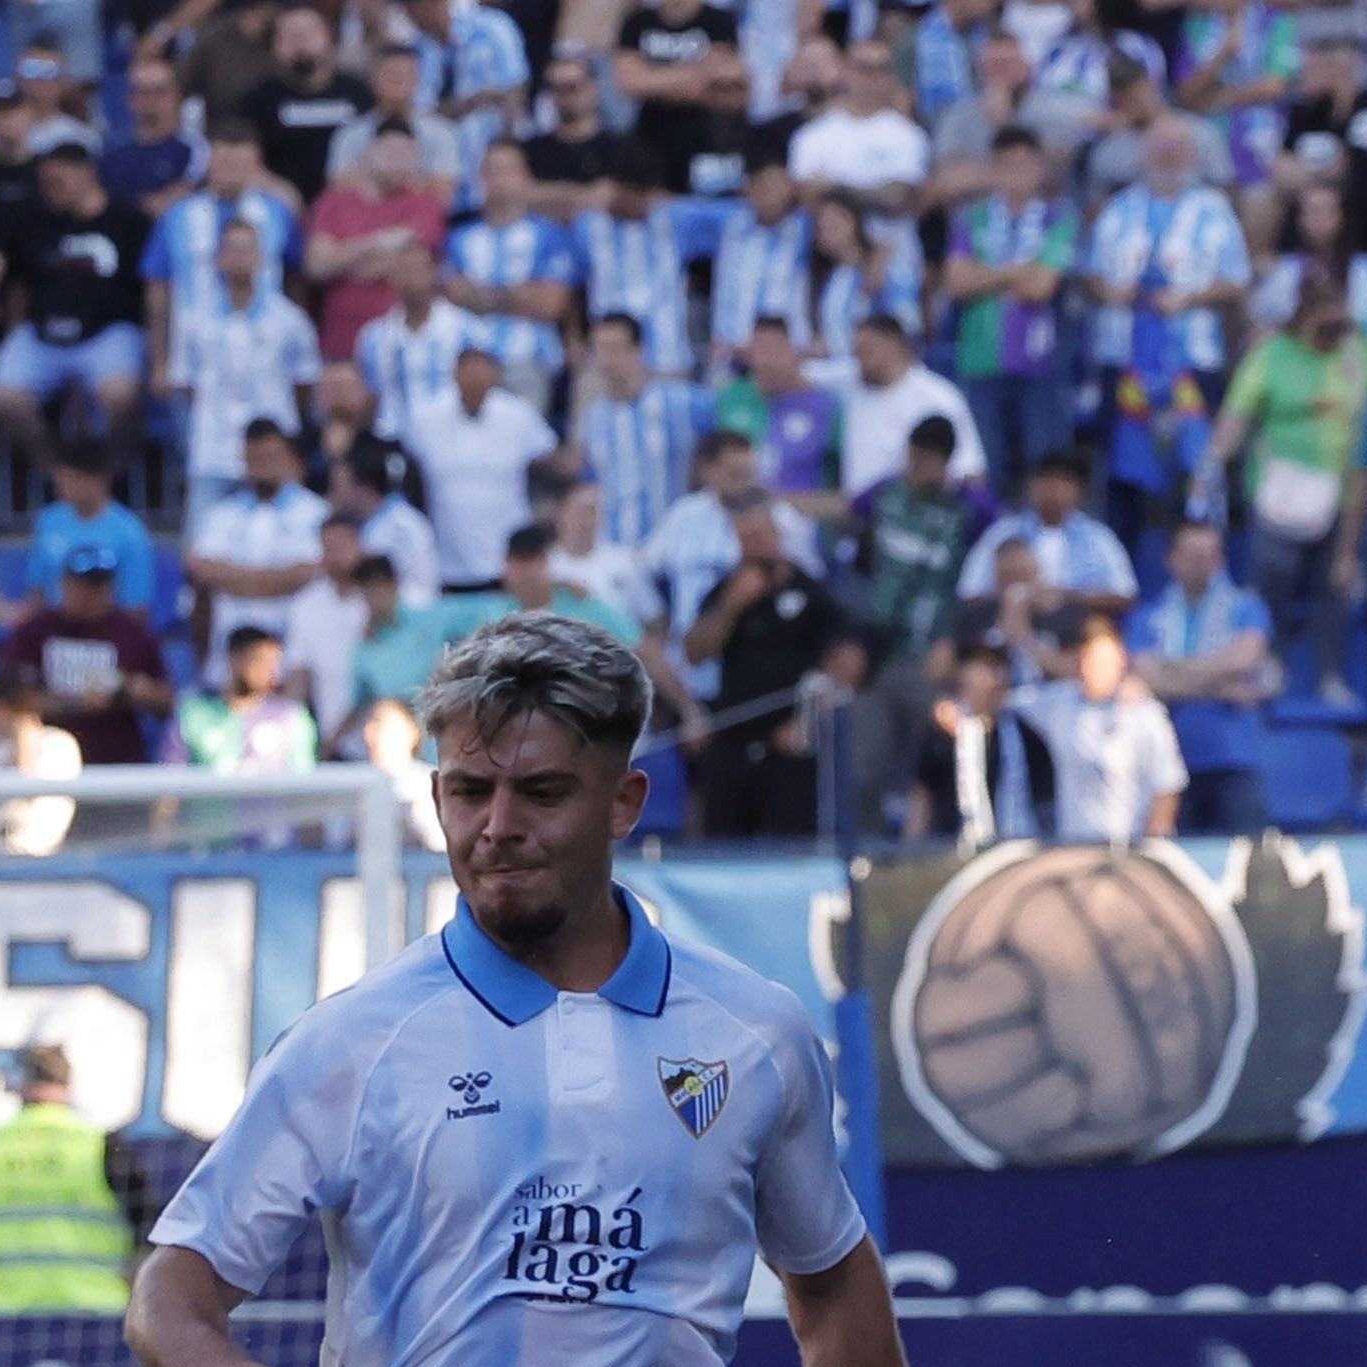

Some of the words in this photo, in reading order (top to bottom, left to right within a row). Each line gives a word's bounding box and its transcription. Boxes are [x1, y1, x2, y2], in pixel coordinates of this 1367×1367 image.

[446, 1099, 501, 1122] hummel
[515, 1176, 583, 1200] sabor
[512, 1203, 531, 1227] a
[534, 1186, 649, 1252] má
[502, 1231, 639, 1303] laga
